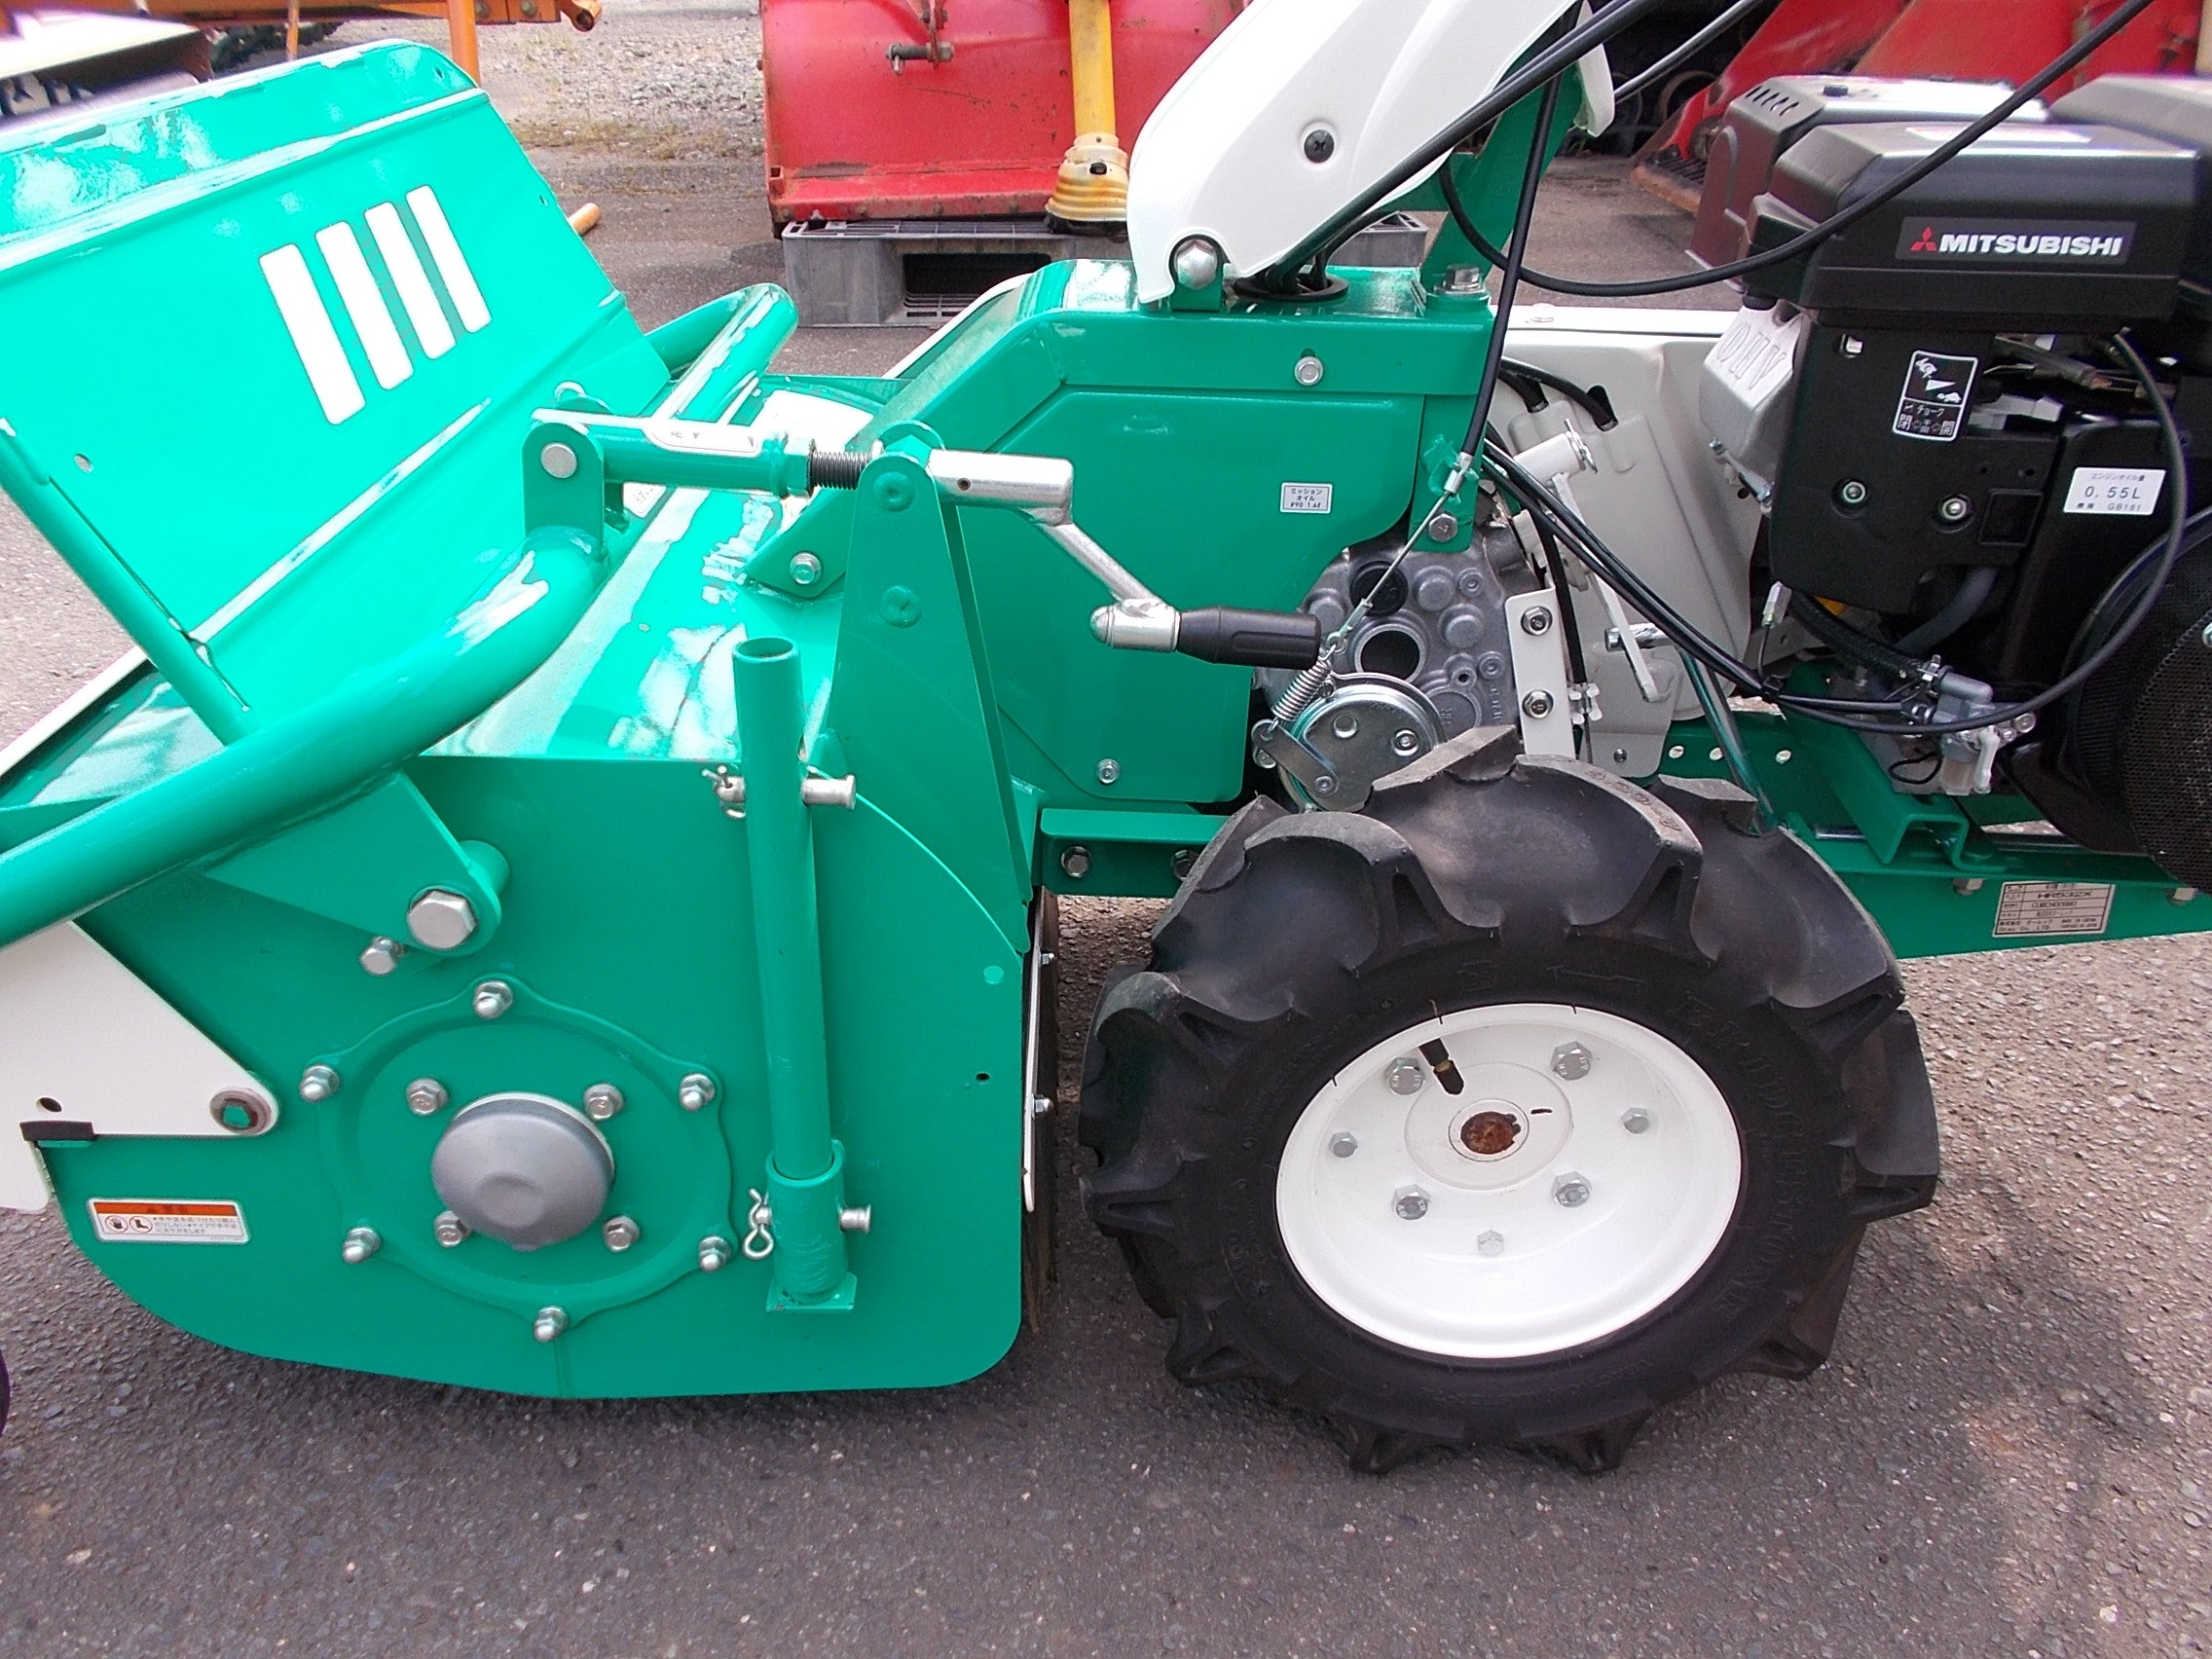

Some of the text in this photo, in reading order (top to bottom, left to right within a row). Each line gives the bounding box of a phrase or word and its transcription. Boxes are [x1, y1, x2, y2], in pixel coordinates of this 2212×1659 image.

[1939, 234, 2123, 255] MITSUBISHI
[1715, 322, 1787, 389] OHV
[1898, 414, 1913, 430] 閉
[1939, 421, 1955, 435] 開
